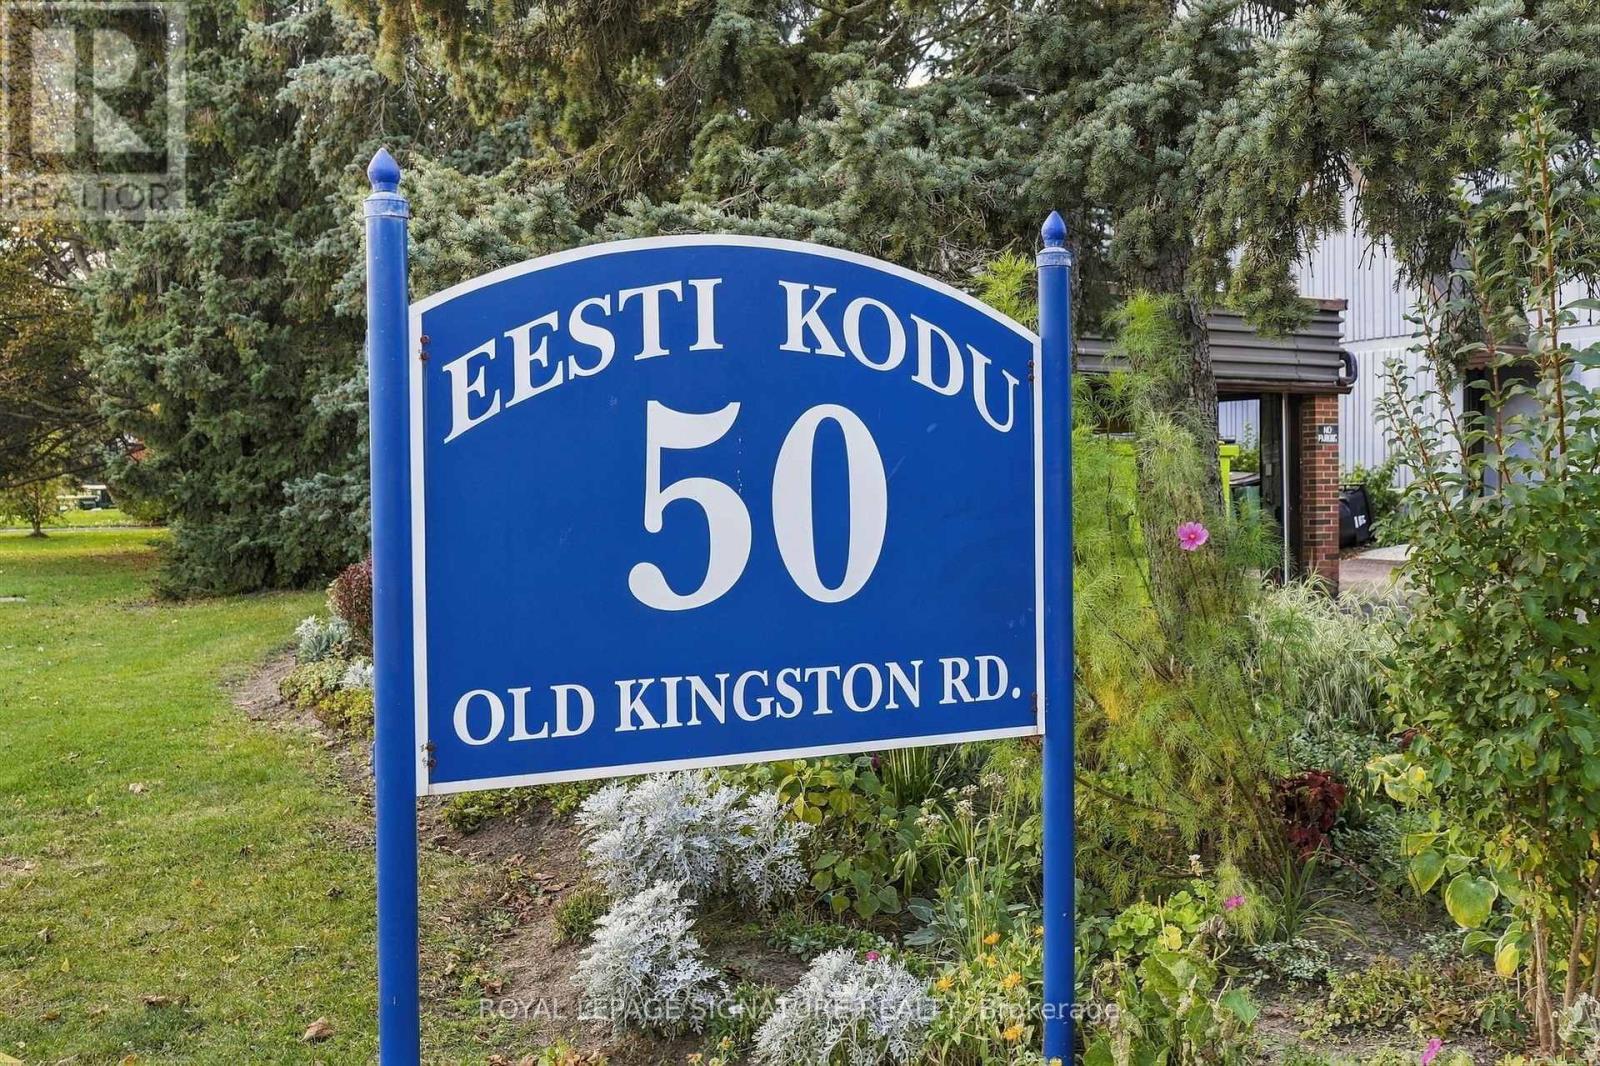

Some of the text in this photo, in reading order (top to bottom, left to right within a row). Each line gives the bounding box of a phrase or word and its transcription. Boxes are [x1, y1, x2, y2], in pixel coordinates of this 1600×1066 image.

[443, 278, 1020, 443] EESTI KODU
[1323, 426, 1332, 434] NO
[629, 401, 888, 612] 50
[453, 655, 1022, 746] OLD KINGSTON RD.
